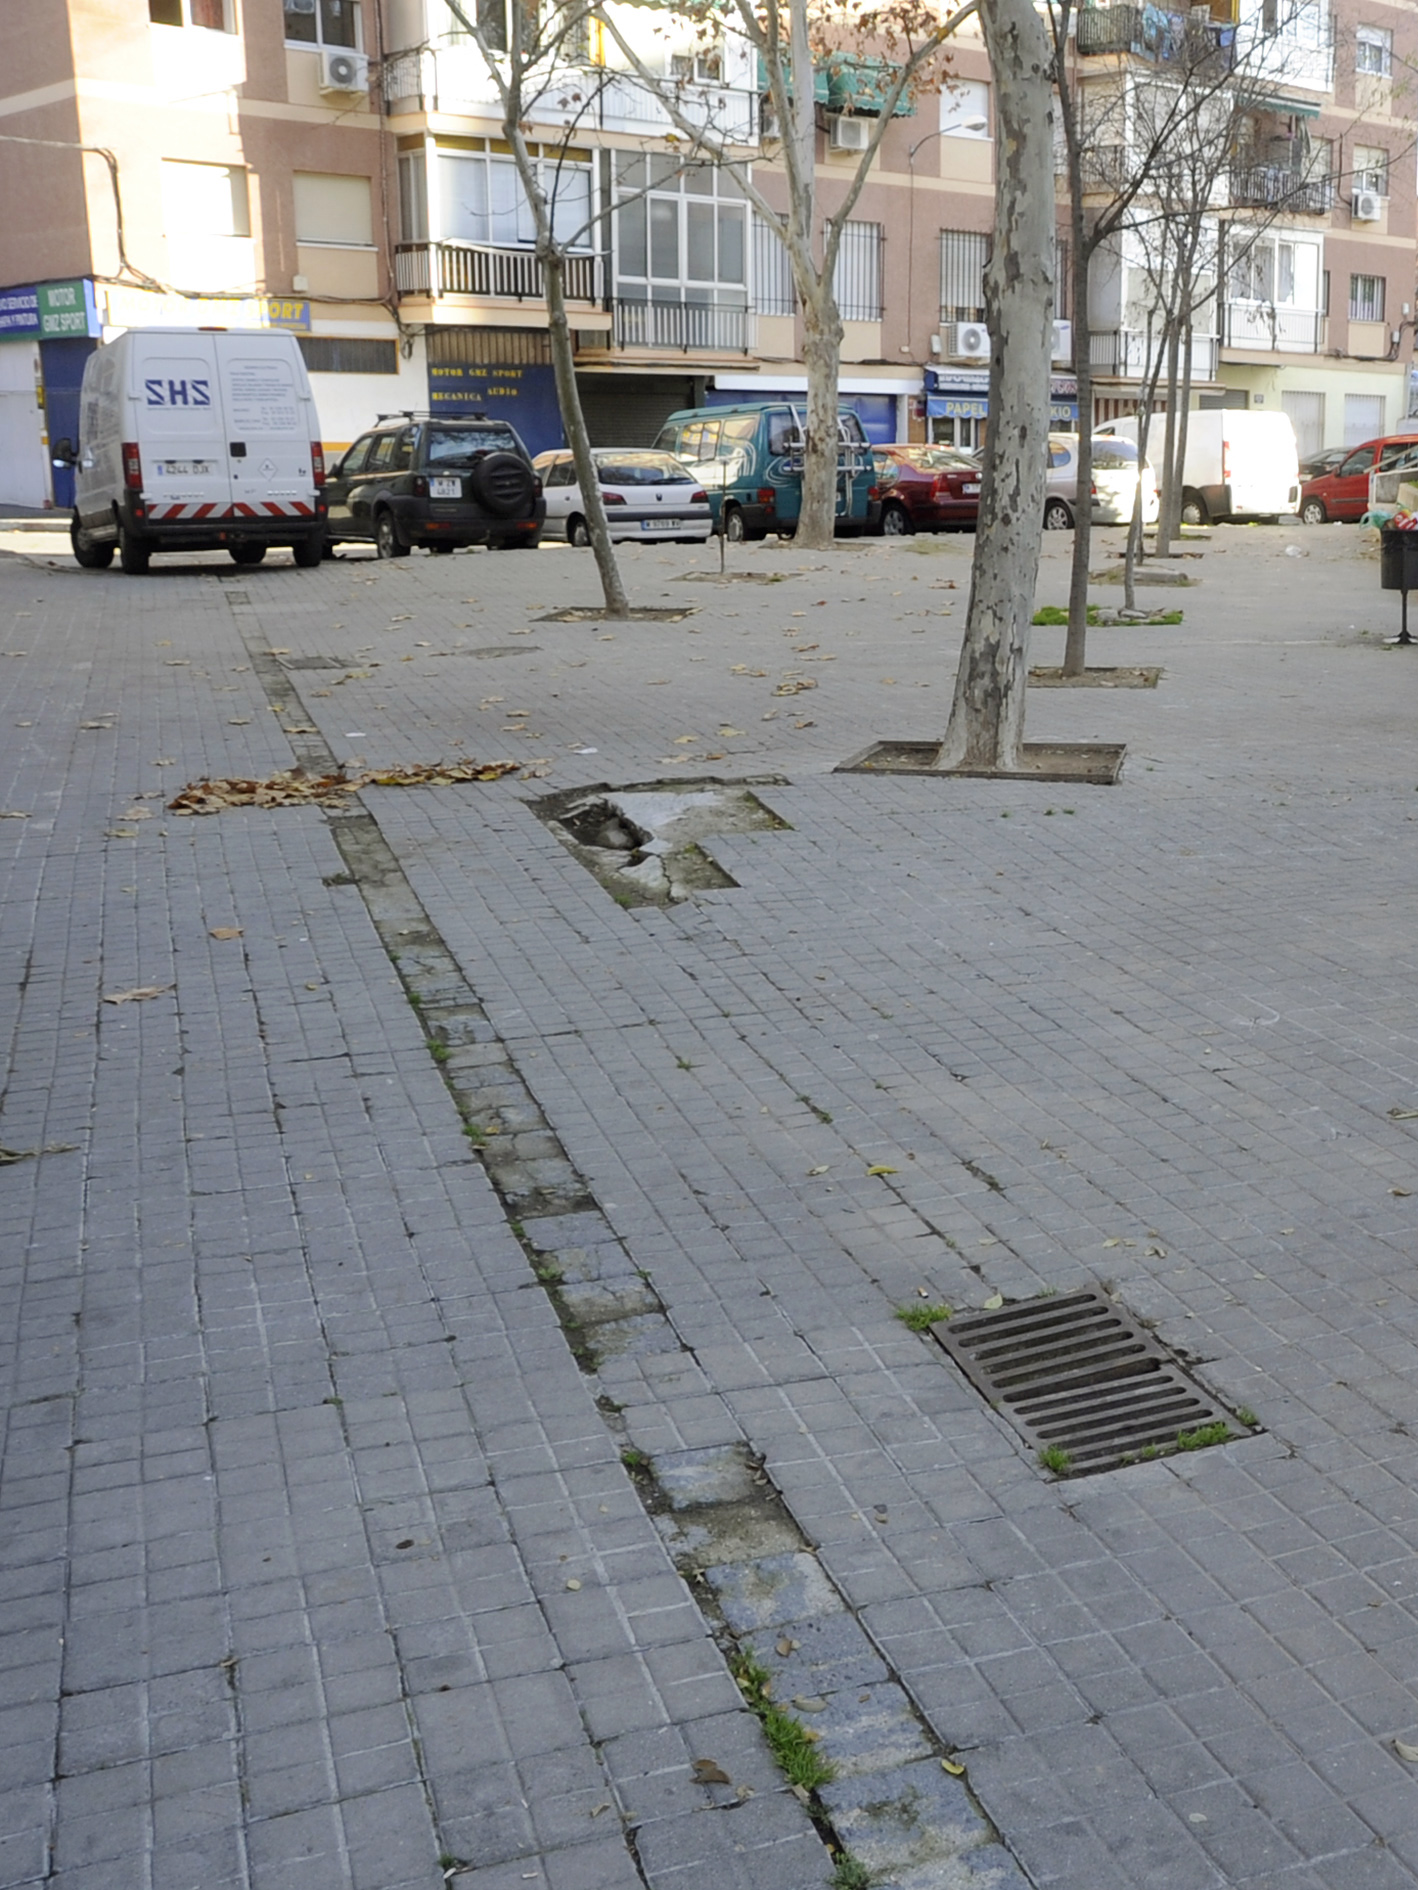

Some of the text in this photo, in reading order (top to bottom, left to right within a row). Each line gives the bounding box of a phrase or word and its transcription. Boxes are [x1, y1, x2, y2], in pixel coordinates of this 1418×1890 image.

[47, 287, 76, 307] MOTOR
[43, 311, 86, 332] GMZ SPORT
[431, 367, 523, 378] MOTOR GMZ SPORT
[145, 379, 211, 405] SHS
[431, 392, 482, 401] MECANICA
[487, 387, 518, 396] AUDIO
[946, 402, 986, 416] PAPEL
